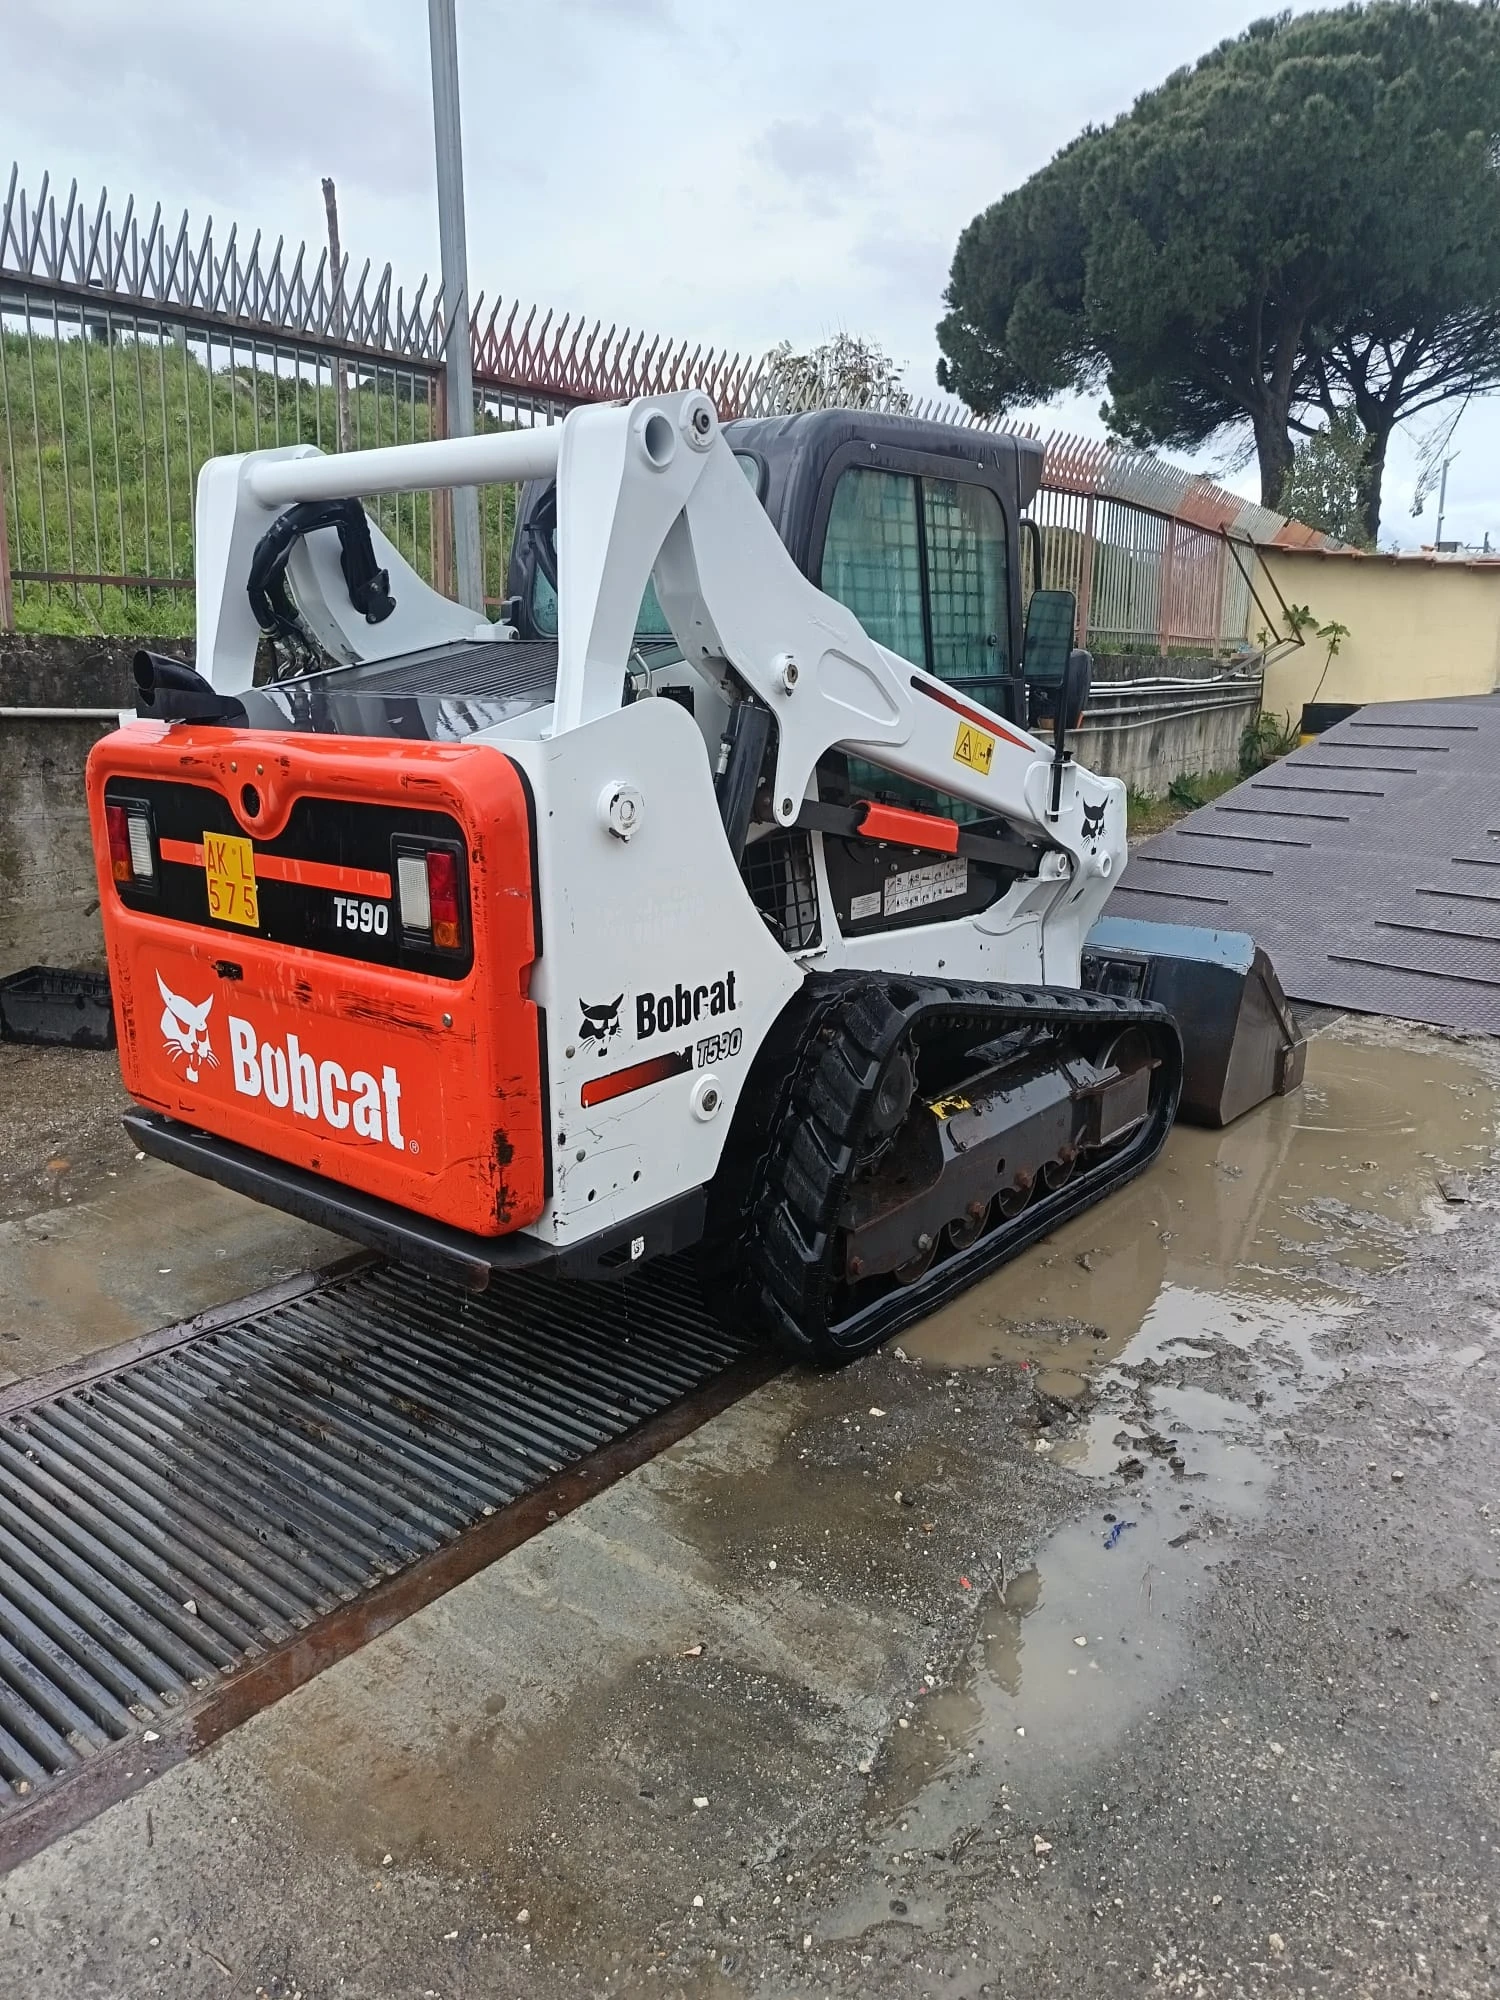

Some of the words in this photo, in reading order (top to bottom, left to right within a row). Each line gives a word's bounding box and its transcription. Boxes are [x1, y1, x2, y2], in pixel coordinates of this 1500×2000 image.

[207, 839, 229, 876] AK
[239, 845, 252, 880] L
[209, 879, 255, 919] 575
[333, 896, 389, 936] T590
[636, 970, 736, 1040] Bobcat
[696, 1027, 742, 1068] T590
[228, 1015, 405, 1151] Bobcat
